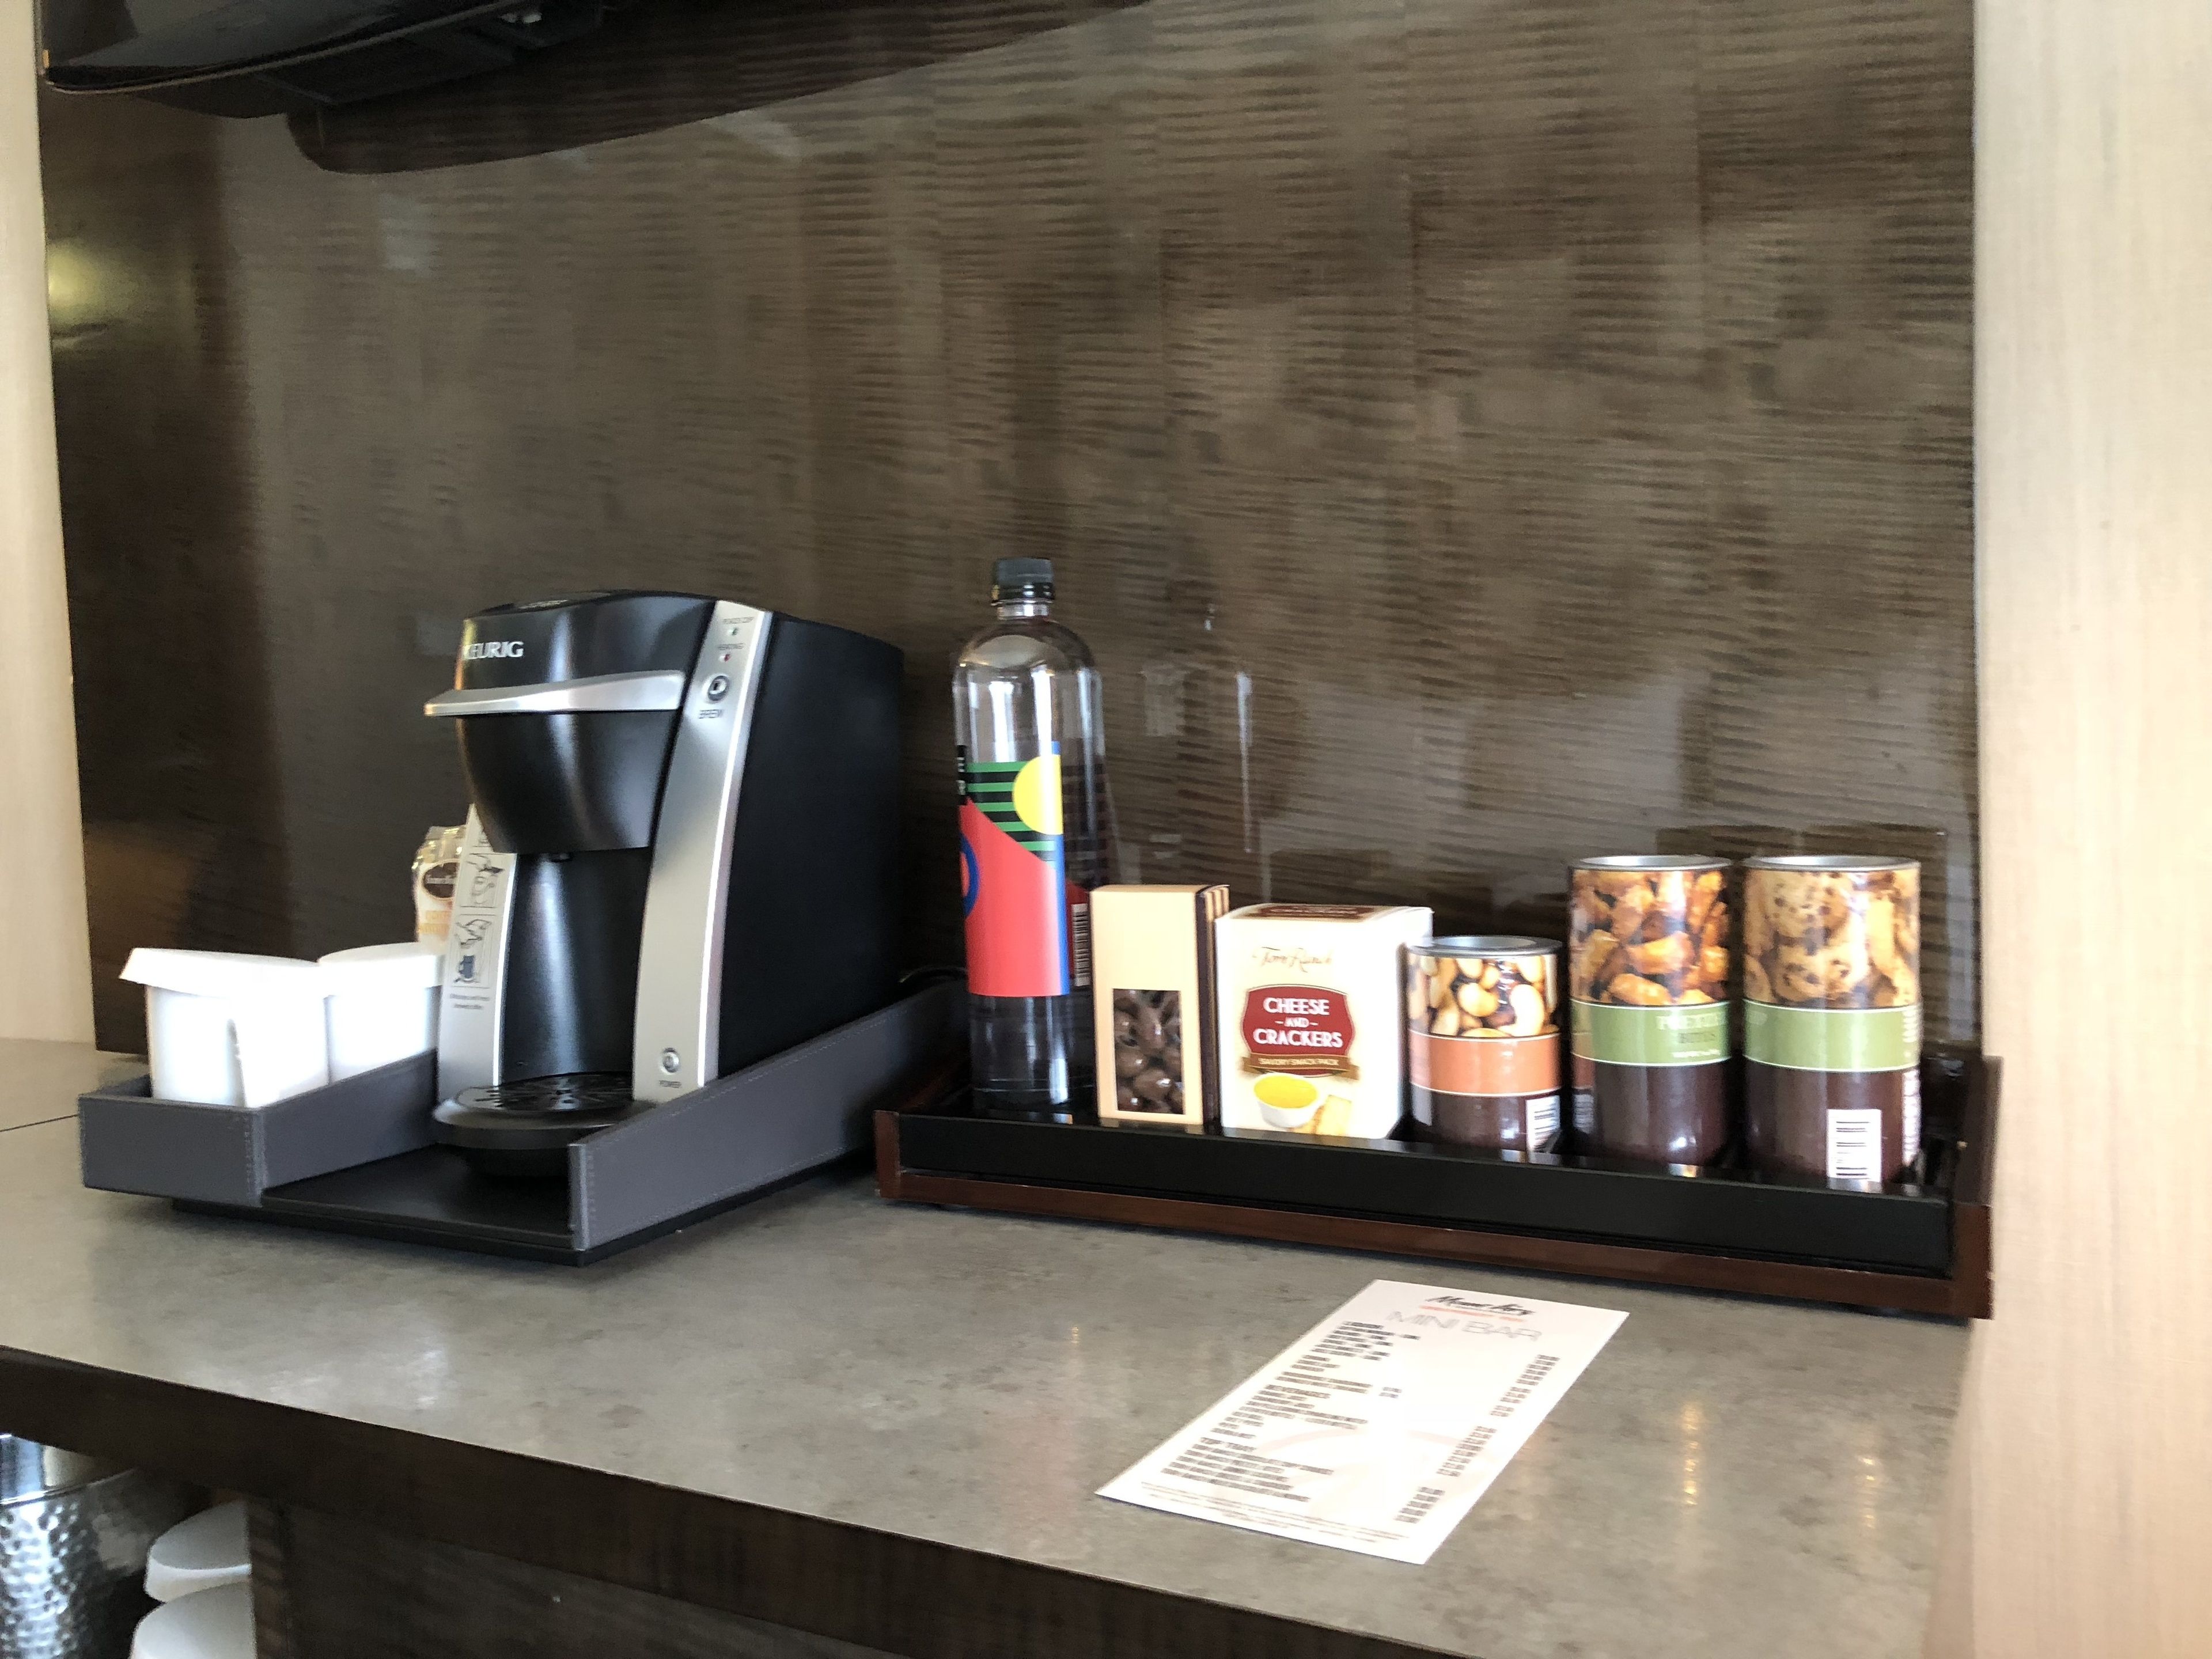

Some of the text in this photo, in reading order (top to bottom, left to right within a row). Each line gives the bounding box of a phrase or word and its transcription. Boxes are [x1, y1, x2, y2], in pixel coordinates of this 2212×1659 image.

[699, 709, 722, 719] BREW
[1263, 997, 1330, 1016] CHEESE
[1253, 1028, 1343, 1048] CRACKERS
[1385, 1310, 1461, 1329] MINI
[1462, 1320, 1543, 1342] BAR
